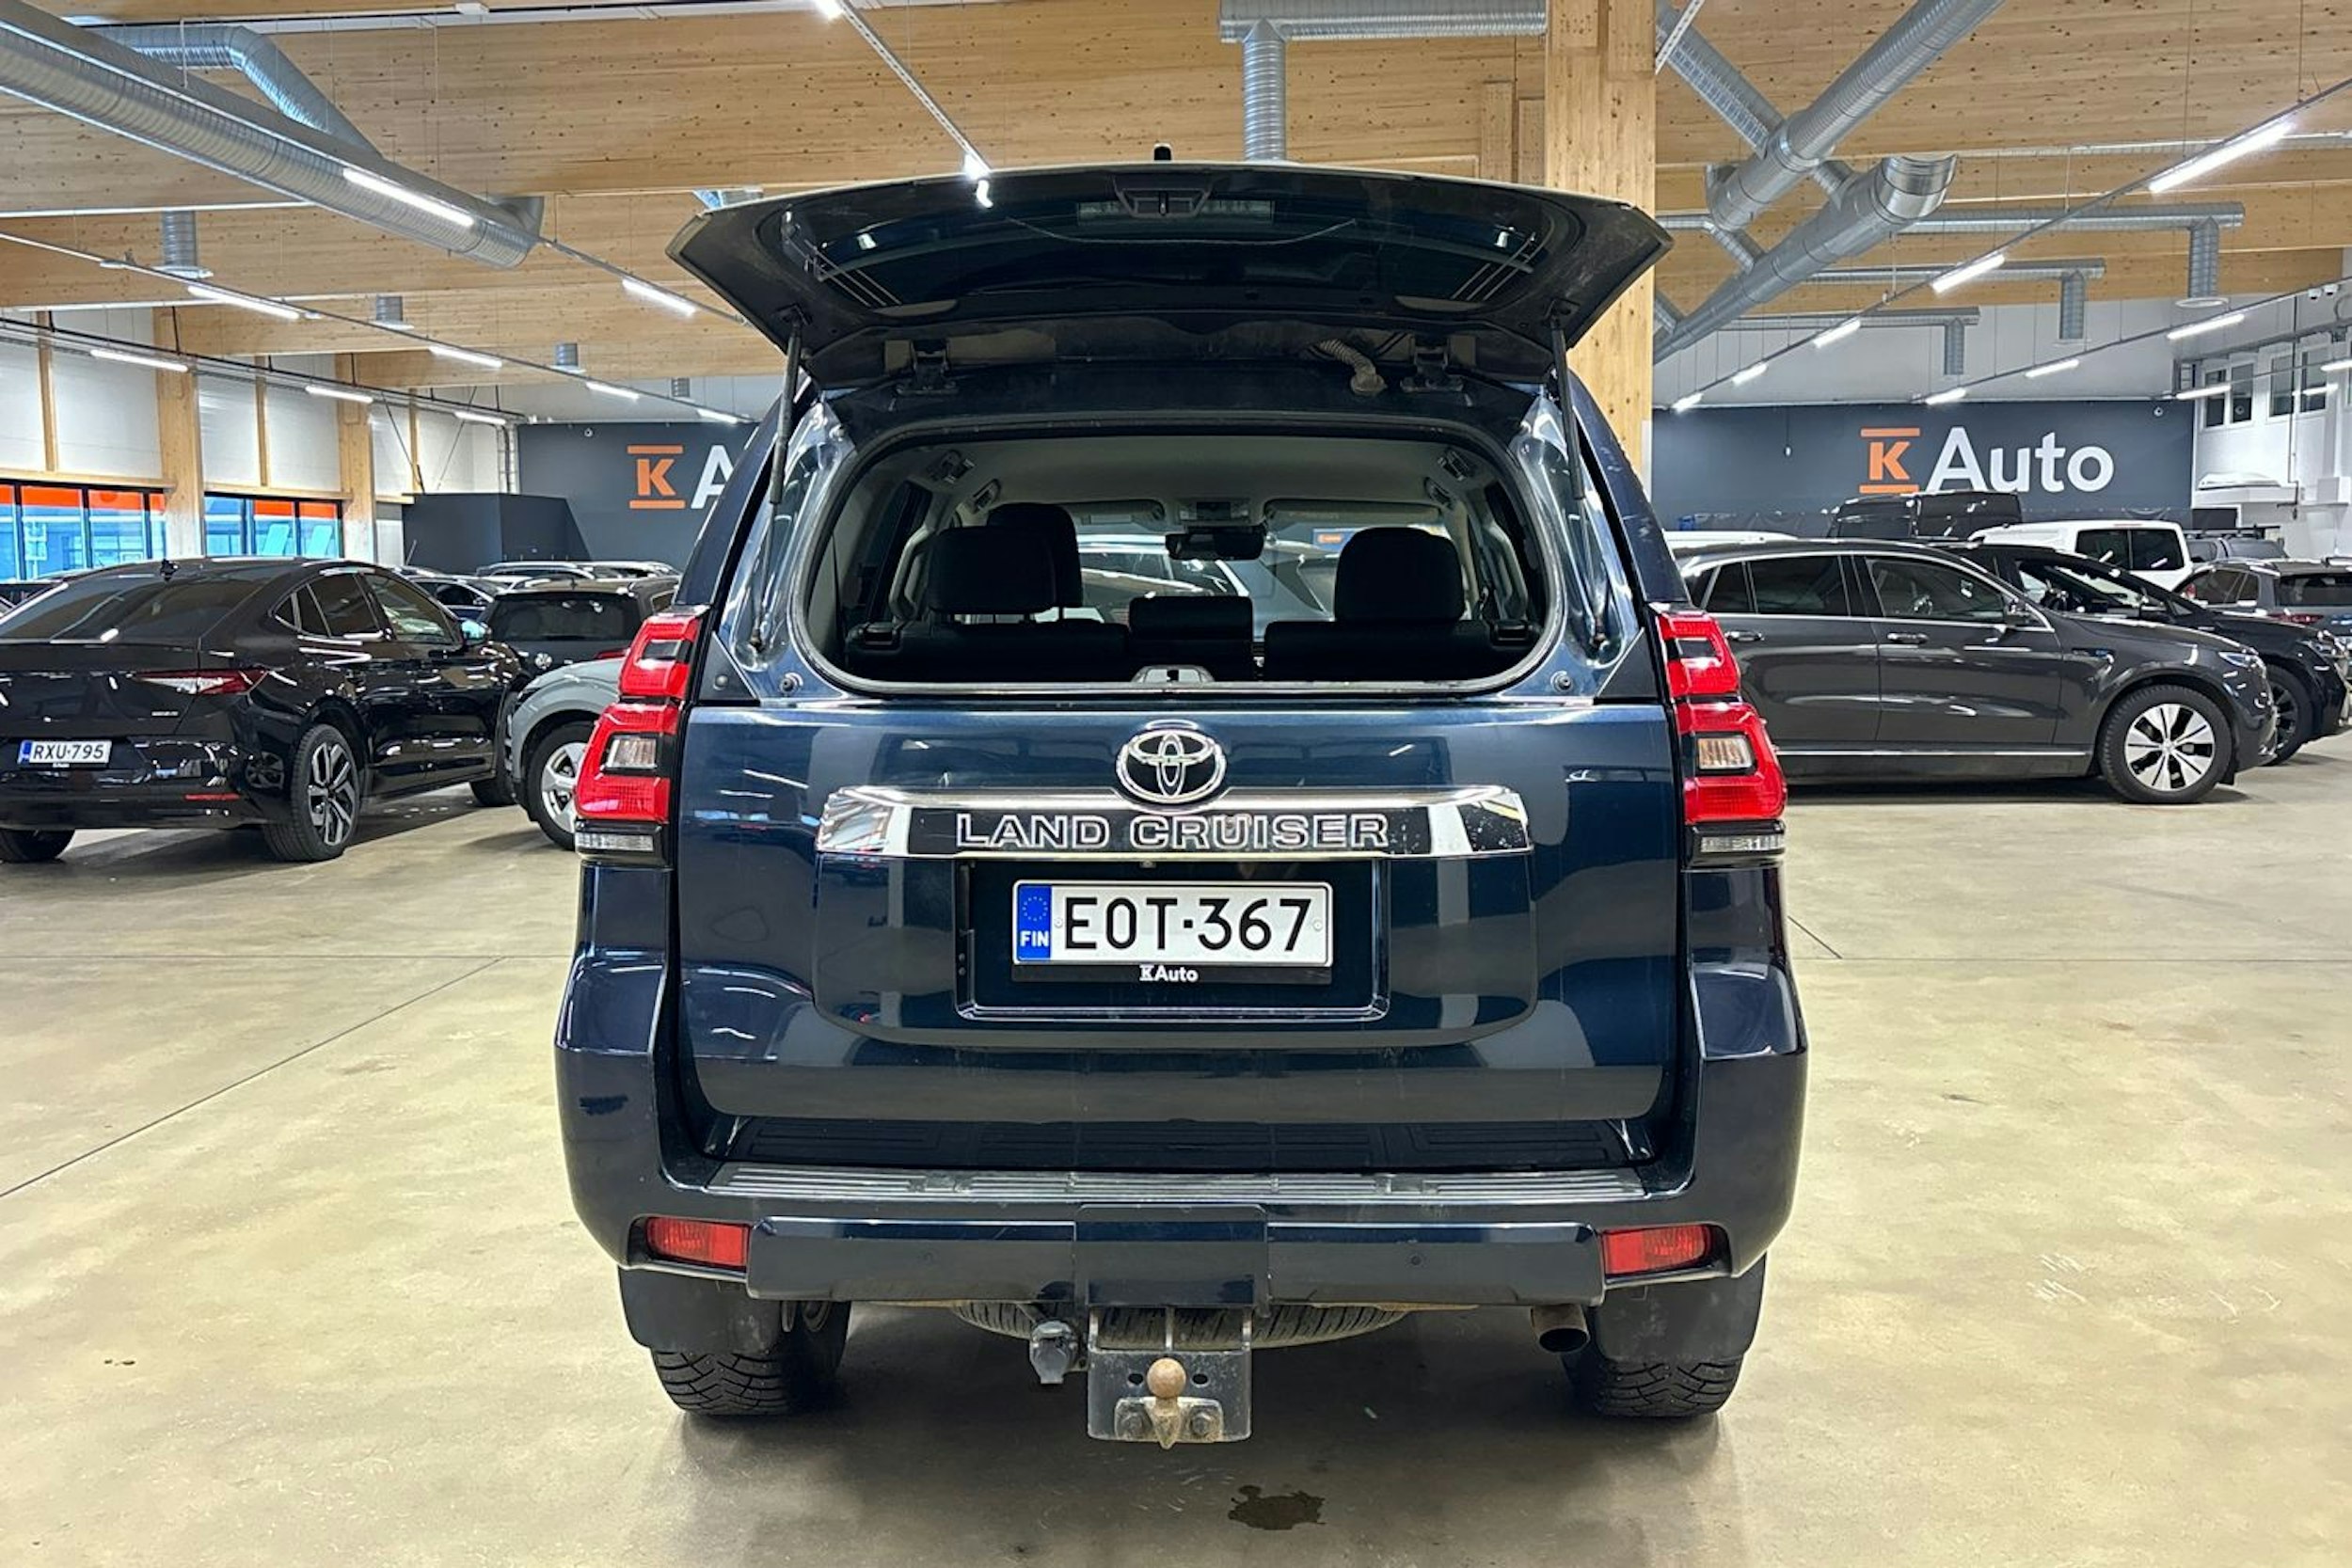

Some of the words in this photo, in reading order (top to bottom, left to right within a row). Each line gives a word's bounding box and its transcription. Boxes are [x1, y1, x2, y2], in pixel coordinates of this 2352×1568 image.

[1925, 426, 2115, 492] Auto
[956, 813, 1110, 848] LAND
[1129, 813, 1390, 848] CRUISER
[1020, 930, 1050, 947] FIN
